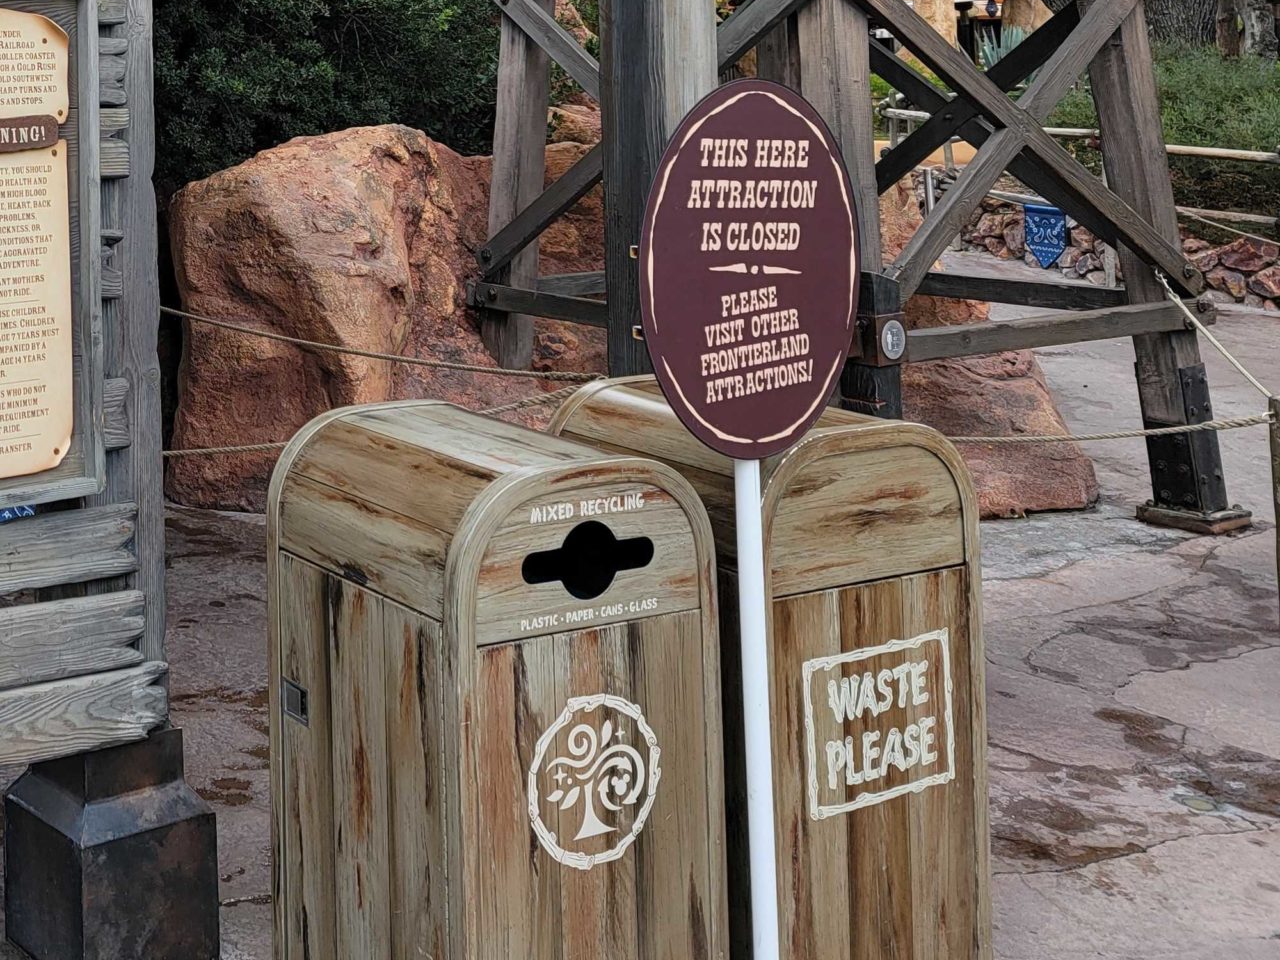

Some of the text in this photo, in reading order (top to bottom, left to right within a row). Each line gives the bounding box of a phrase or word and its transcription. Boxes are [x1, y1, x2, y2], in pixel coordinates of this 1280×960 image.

[17, 63, 35, 71] GOLD
[12, 74, 53, 82] SOUTHWEST
[700, 138, 809, 168] THIS HERE
[11, 167, 24, 175] YOU
[26, 165, 52, 174] SHOULD
[7, 190, 23, 198] HIGH
[25, 189, 46, 197] BLOOD
[688, 180, 818, 209] ATTRACTION
[33, 200, 51, 208] BACK
[35, 235, 53, 243] THAT
[701, 222, 801, 251] IS CLOSED
[3, 247, 47, 258] AGGRAVATED
[12, 275, 44, 285] MOTHERS
[0, 290, 12, 298] NOT
[721, 286, 778, 318] PLEASE
[11, 306, 46, 317] CHILDREN
[20, 317, 55, 329] CHILDREN
[704, 309, 799, 348] VISIT OTHER
[1, 358, 14, 367] AGE
[23, 354, 46, 363] YEARS
[701, 334, 810, 376] FRONTIERLAND
[706, 359, 814, 404] ATTRACTIONS!
[7, 388, 22, 398] WHO
[23, 387, 32, 396] DO
[34, 385, 47, 395] NOT
[7, 398, 38, 410] MINIMUM
[0, 409, 49, 423] REQUIREMENT
[530, 493, 645, 524] MIXED RECYCLING
[521, 598, 658, 631] PLASTIC PAPER CANS GLASS
[825, 660, 929, 723] WASTE
[825, 717, 939, 790] PLEASE
